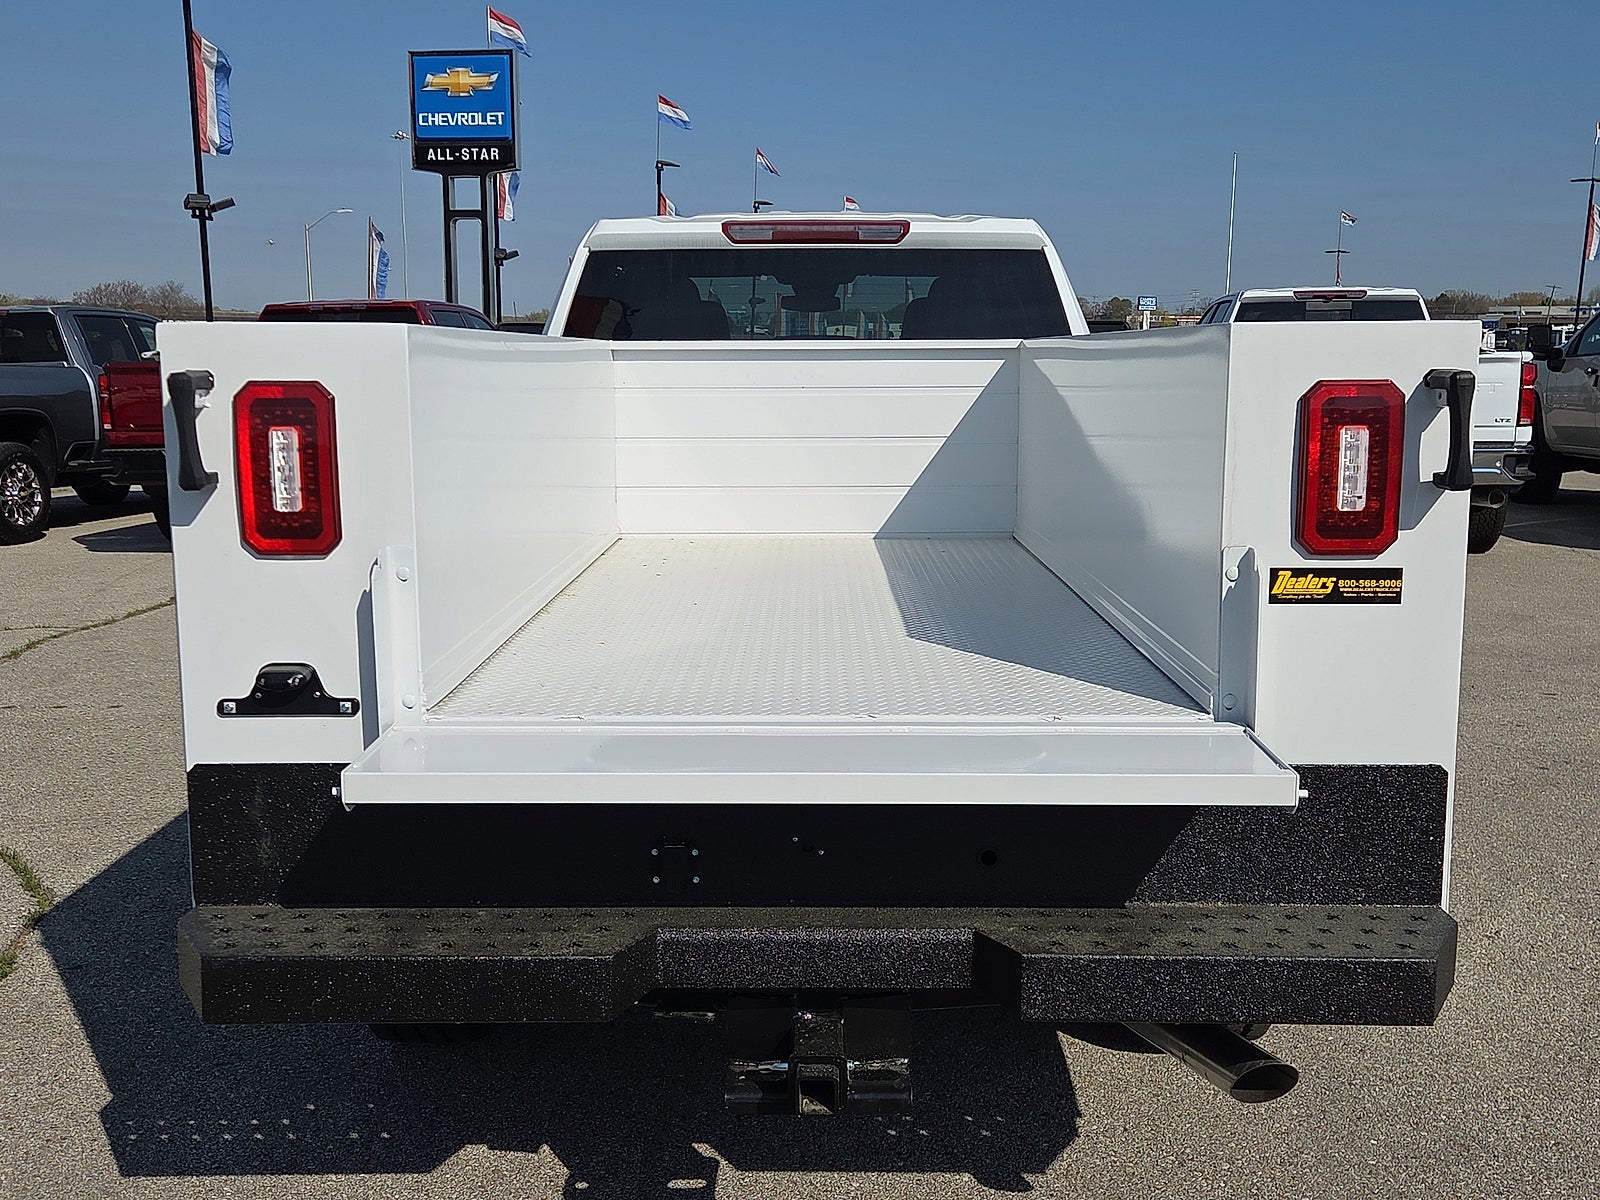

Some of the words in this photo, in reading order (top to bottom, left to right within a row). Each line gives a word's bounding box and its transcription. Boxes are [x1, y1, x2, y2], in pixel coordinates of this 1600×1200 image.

[418, 112, 505, 126] CHEVROLET
[427, 148, 499, 161] ALL-STAR
[1271, 570, 1336, 594] Dealers
[1338, 579, 1402, 587] 800-568-9006
